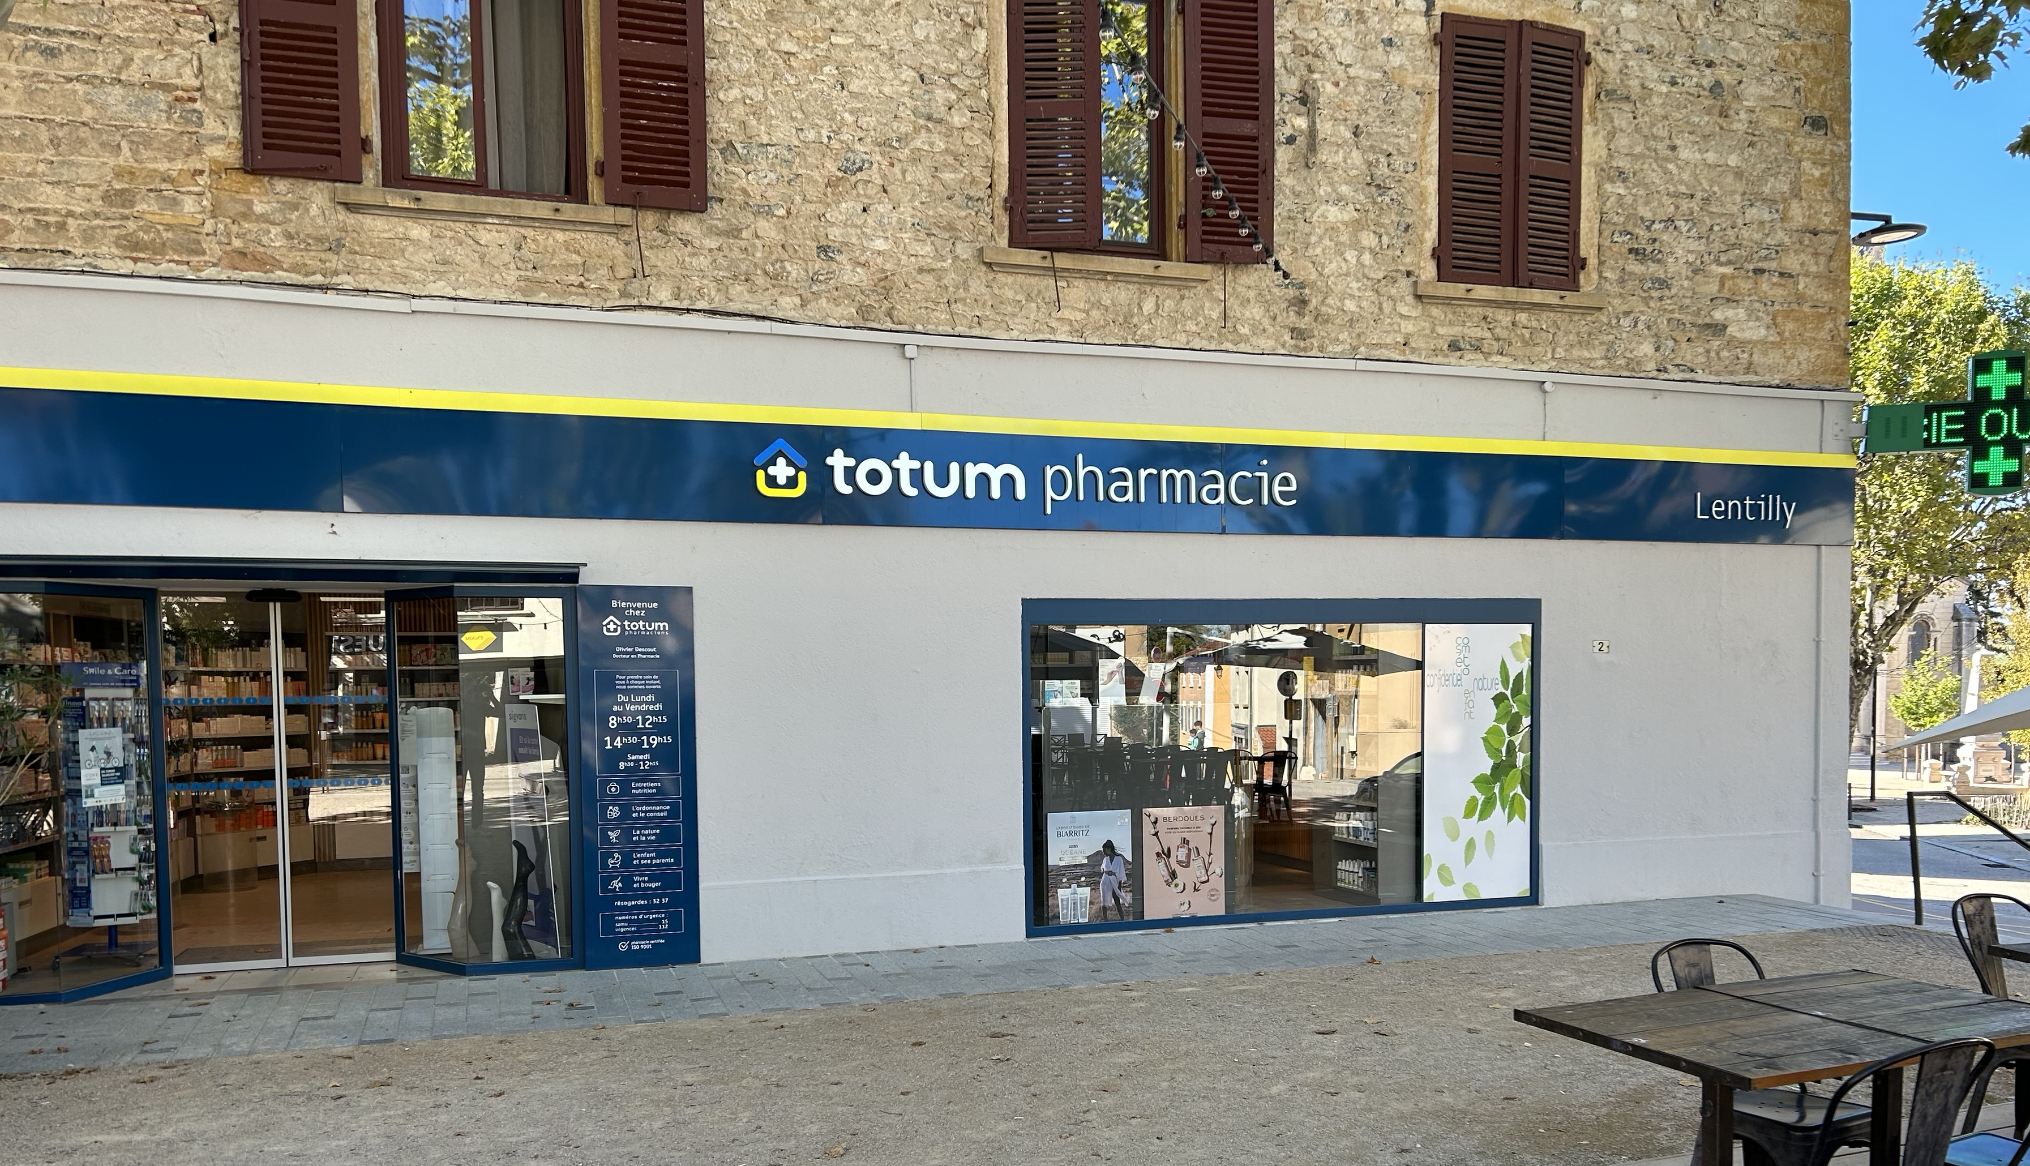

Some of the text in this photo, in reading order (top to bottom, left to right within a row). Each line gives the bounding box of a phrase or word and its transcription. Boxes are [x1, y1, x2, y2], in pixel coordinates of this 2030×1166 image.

[825, 448, 1298, 516] totum pharmacie
[1695, 491, 1797, 530] Lentilly
[611, 600, 658, 608] Bienvenue
[623, 620, 668, 631] totum
[1597, 642, 1605, 652] 2
[114, 666, 137, 675] Care
[1426, 669, 1500, 693] confidentiel nature
[618, 694, 655, 702] Du Lundi
[625, 703, 663, 711] Vendredi
[1056, 829, 1090, 838] BIARRITZ
